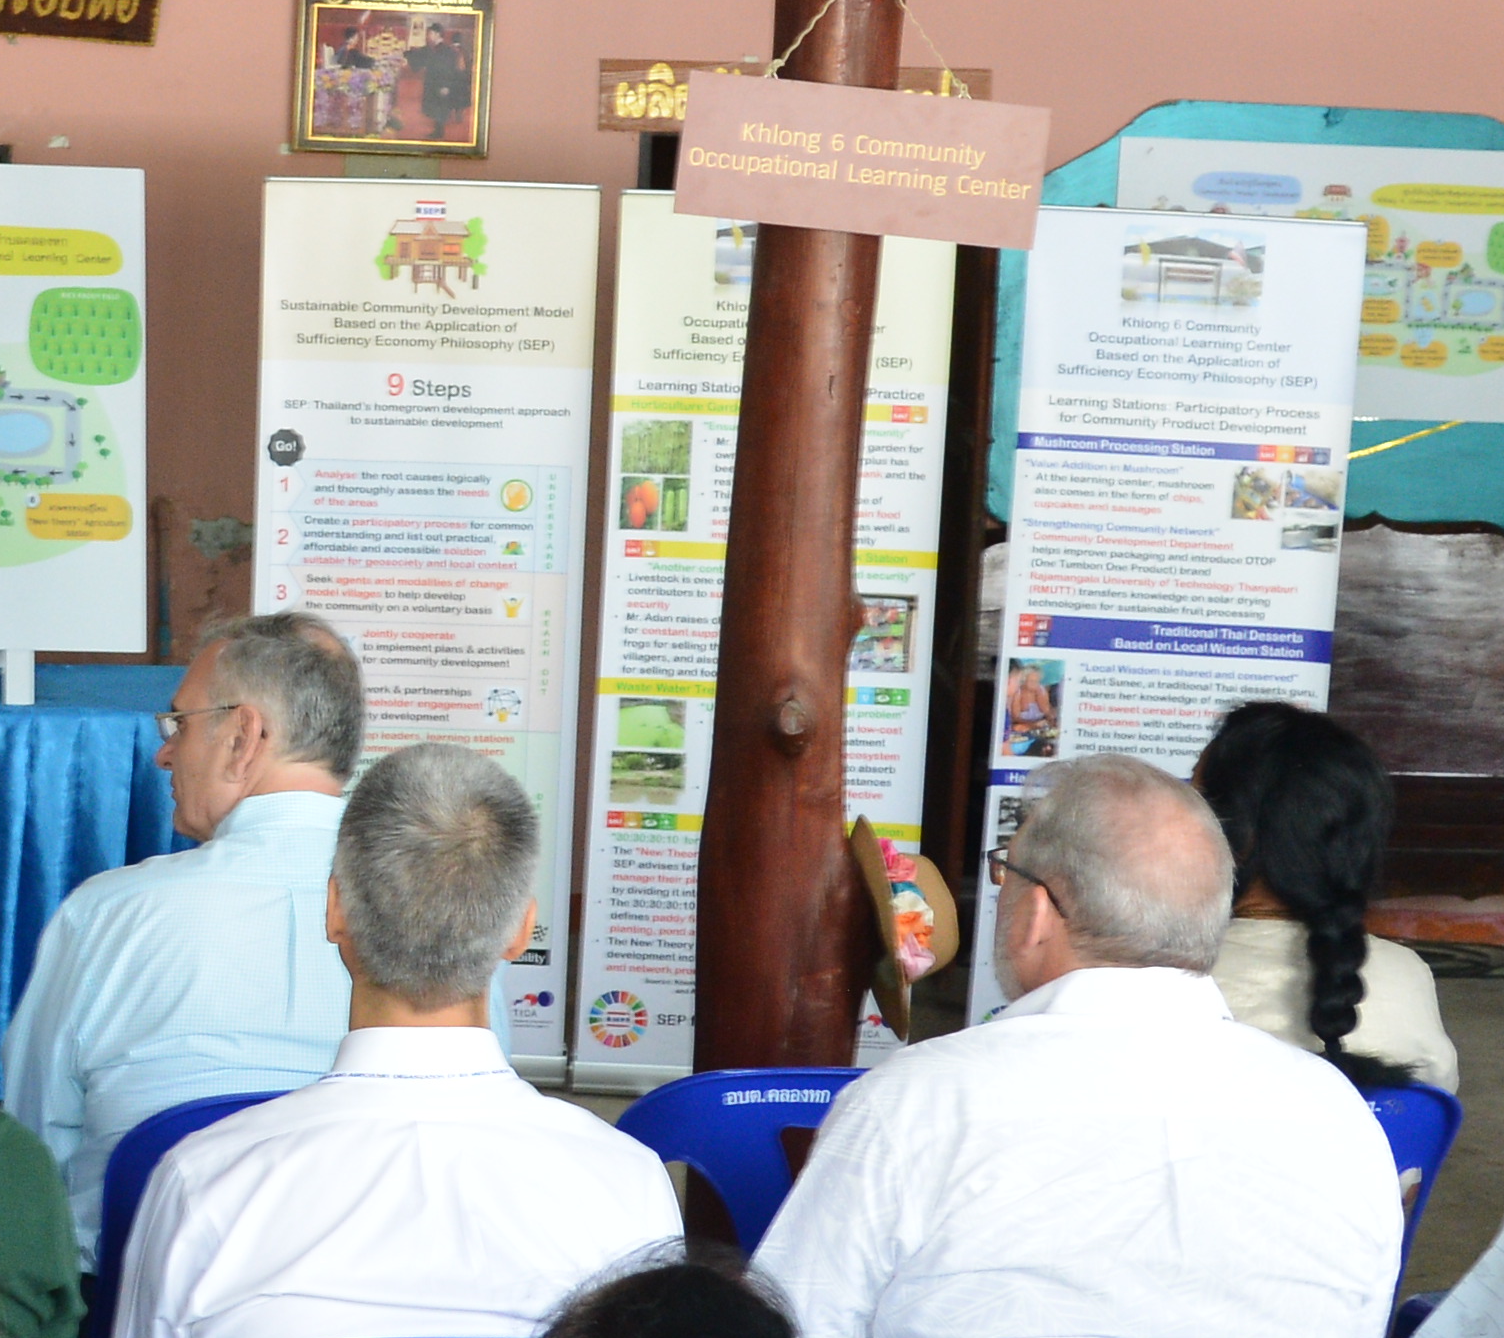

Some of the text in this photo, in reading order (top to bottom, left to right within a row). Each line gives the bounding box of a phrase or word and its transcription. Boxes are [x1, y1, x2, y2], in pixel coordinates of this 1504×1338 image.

[742, 122, 987, 169] Khlong 6 Community
[689, 147, 1032, 200] Occupational Learning Center
[21, 252, 69, 265] Learning
[75, 253, 112, 264] Center
[280, 299, 574, 319] Sustainable Community Development Model
[333, 317, 518, 335] Based on the Application of
[1122, 317, 1262, 336] Khlong 6 Community
[296, 333, 556, 353] Sufficiency Economy Philosophy (SEP)
[1088, 332, 1292, 353] Occupational Learning Center
[653, 348, 728, 364] Sufficiency
[875, 356, 913, 372] (SEP)
[1095, 348, 1281, 370] Based on the Application of
[387, 373, 472, 400] 9 Steps
[1057, 364, 1319, 390] Sufficiency Economy Philosophy (SEP)
[284, 399, 571, 419] SEP: Thailand's homegrown development approach
[1048, 395, 1321, 418] Learning Stations: Participatory Process
[350, 415, 504, 431] to sustainable development
[1059, 411, 1307, 437] for Community Product Development
[275, 440, 297, 452] Go!
[1034, 436, 1215, 456] Mushroom Processing Station
[280, 477, 289, 492] 1
[277, 529, 289, 545] 2
[276, 585, 288, 600] 3
[1153, 625, 1303, 643] Traditional Thai Desserts
[1115, 638, 1304, 658] Based on Local Wisdom Station
